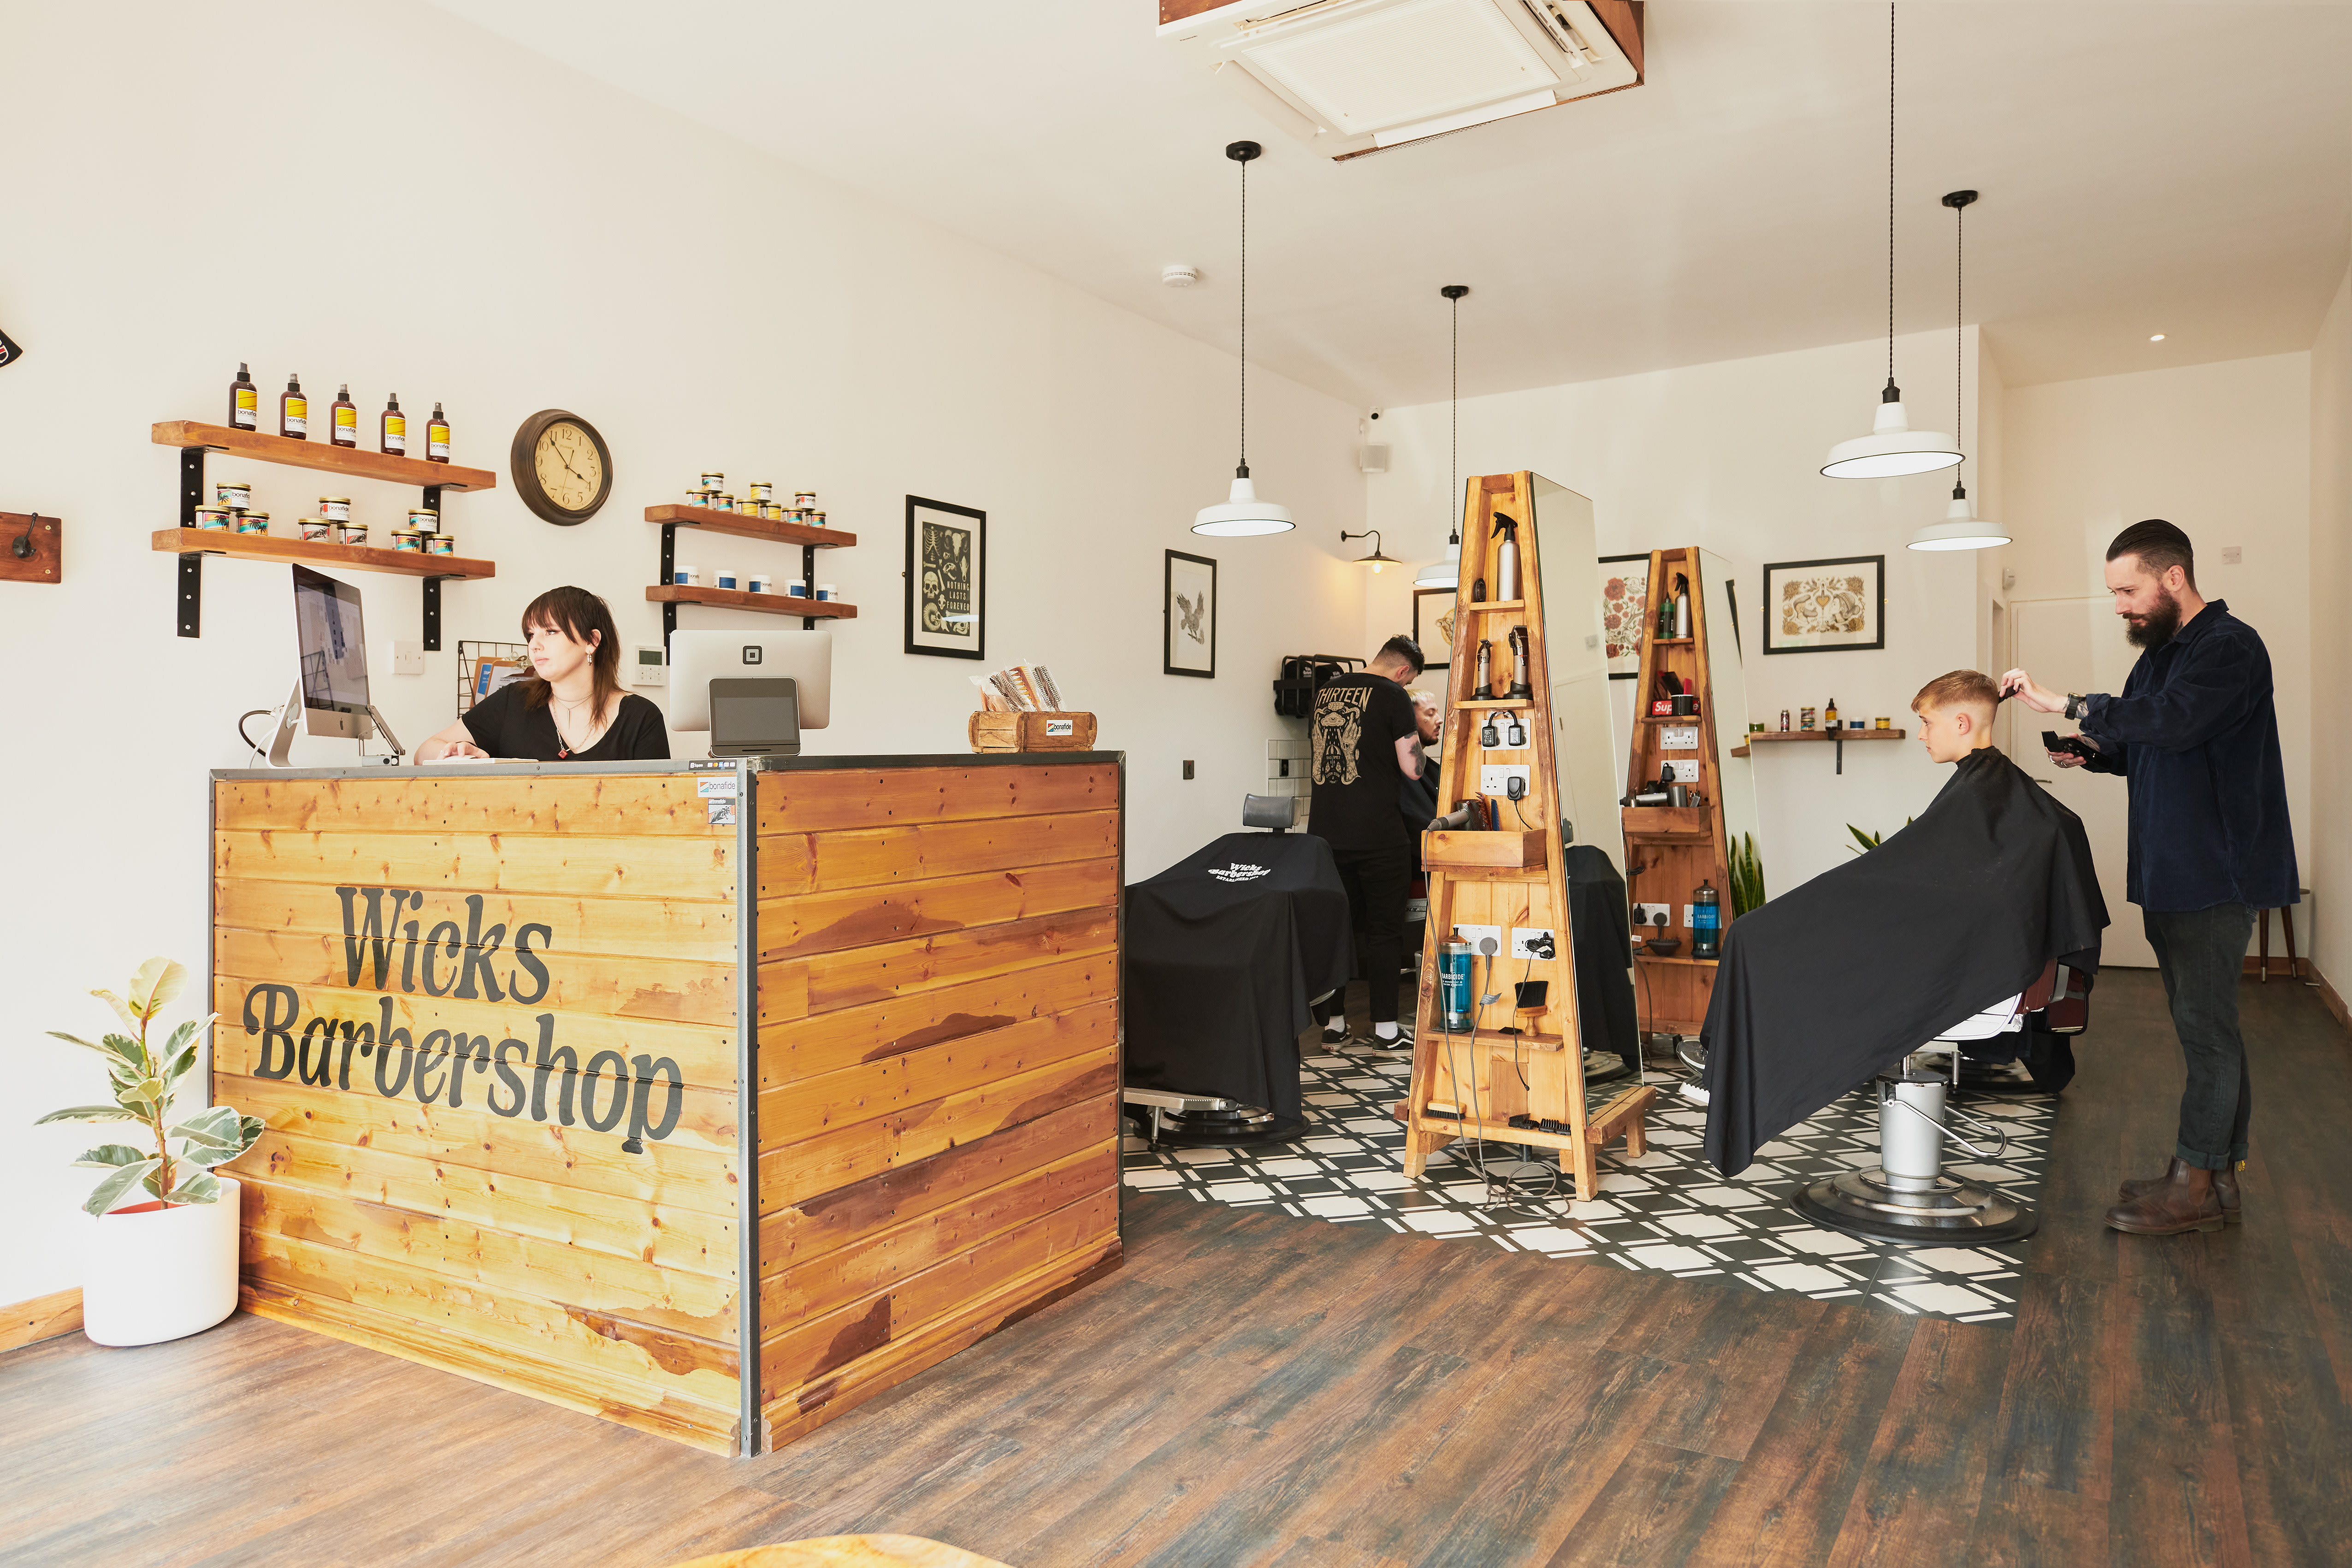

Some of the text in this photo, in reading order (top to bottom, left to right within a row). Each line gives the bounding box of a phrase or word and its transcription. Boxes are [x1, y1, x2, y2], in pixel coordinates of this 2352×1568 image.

[550, 430, 557, 441] 11
[562, 429, 572, 440] 12
[539, 440, 549, 452] 10
[579, 436, 581, 446] 1
[587, 449, 593, 461] 2
[535, 455, 543, 467] 9
[590, 466, 597, 477] 3
[539, 473, 547, 485] 8
[585, 481, 592, 492] 4
[550, 487, 557, 498] 7
[577, 491, 583, 503] 5
[562, 492, 570, 505] 6
[947, 581, 969, 591] NOTHING
[950, 591, 966, 600] LASTS
[946, 601, 969, 611] FOREVER
[1314, 687, 1373, 712] THIRTEEN
[1655, 702, 1698, 714] Supe
[709, 781, 736, 790] bonafide
[1208, 869, 1271, 878] Barbershop
[336, 886, 552, 1005] Wicks
[243, 983, 684, 1155] Barbershop
